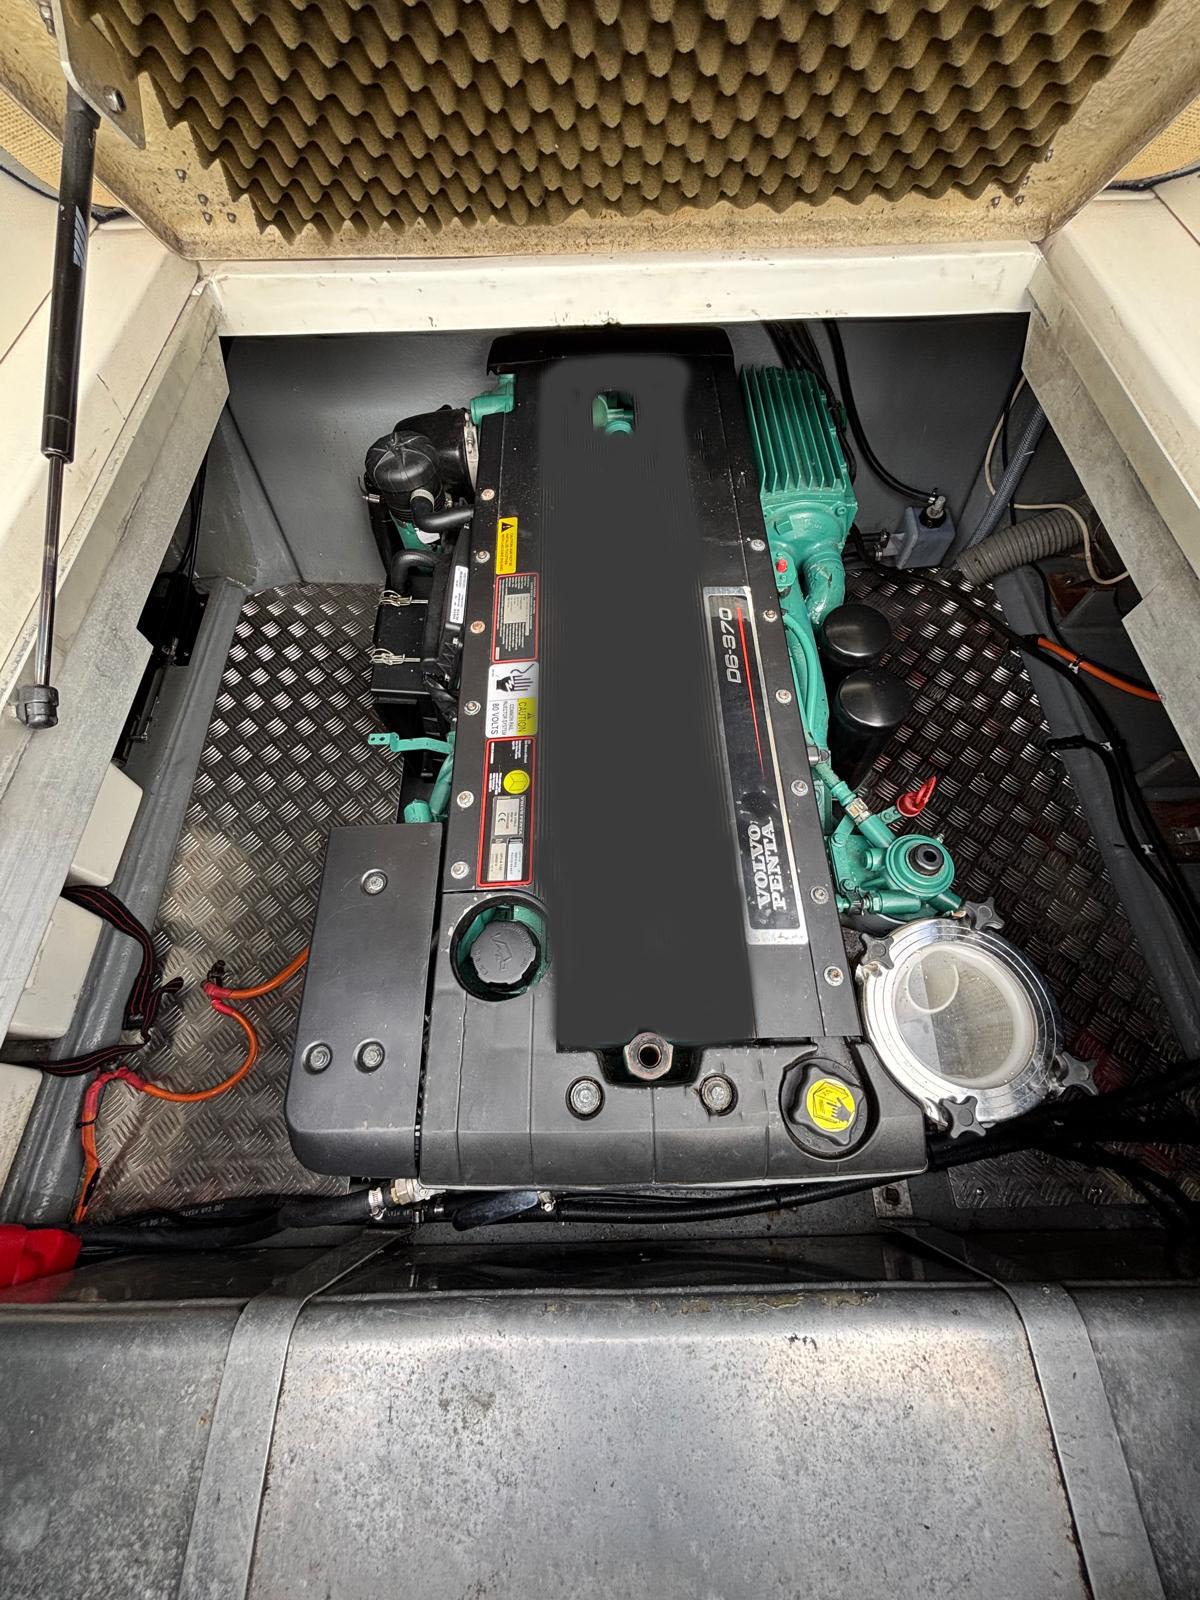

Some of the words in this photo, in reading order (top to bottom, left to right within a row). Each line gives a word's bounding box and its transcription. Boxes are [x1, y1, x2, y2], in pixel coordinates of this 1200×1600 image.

[719, 607, 741, 683] D6-370
[491, 711, 499, 735] VOLTS
[517, 701, 527, 733] CAUTION
[748, 824, 771, 910] VOLVO
[761, 816, 787, 911] PENTA
